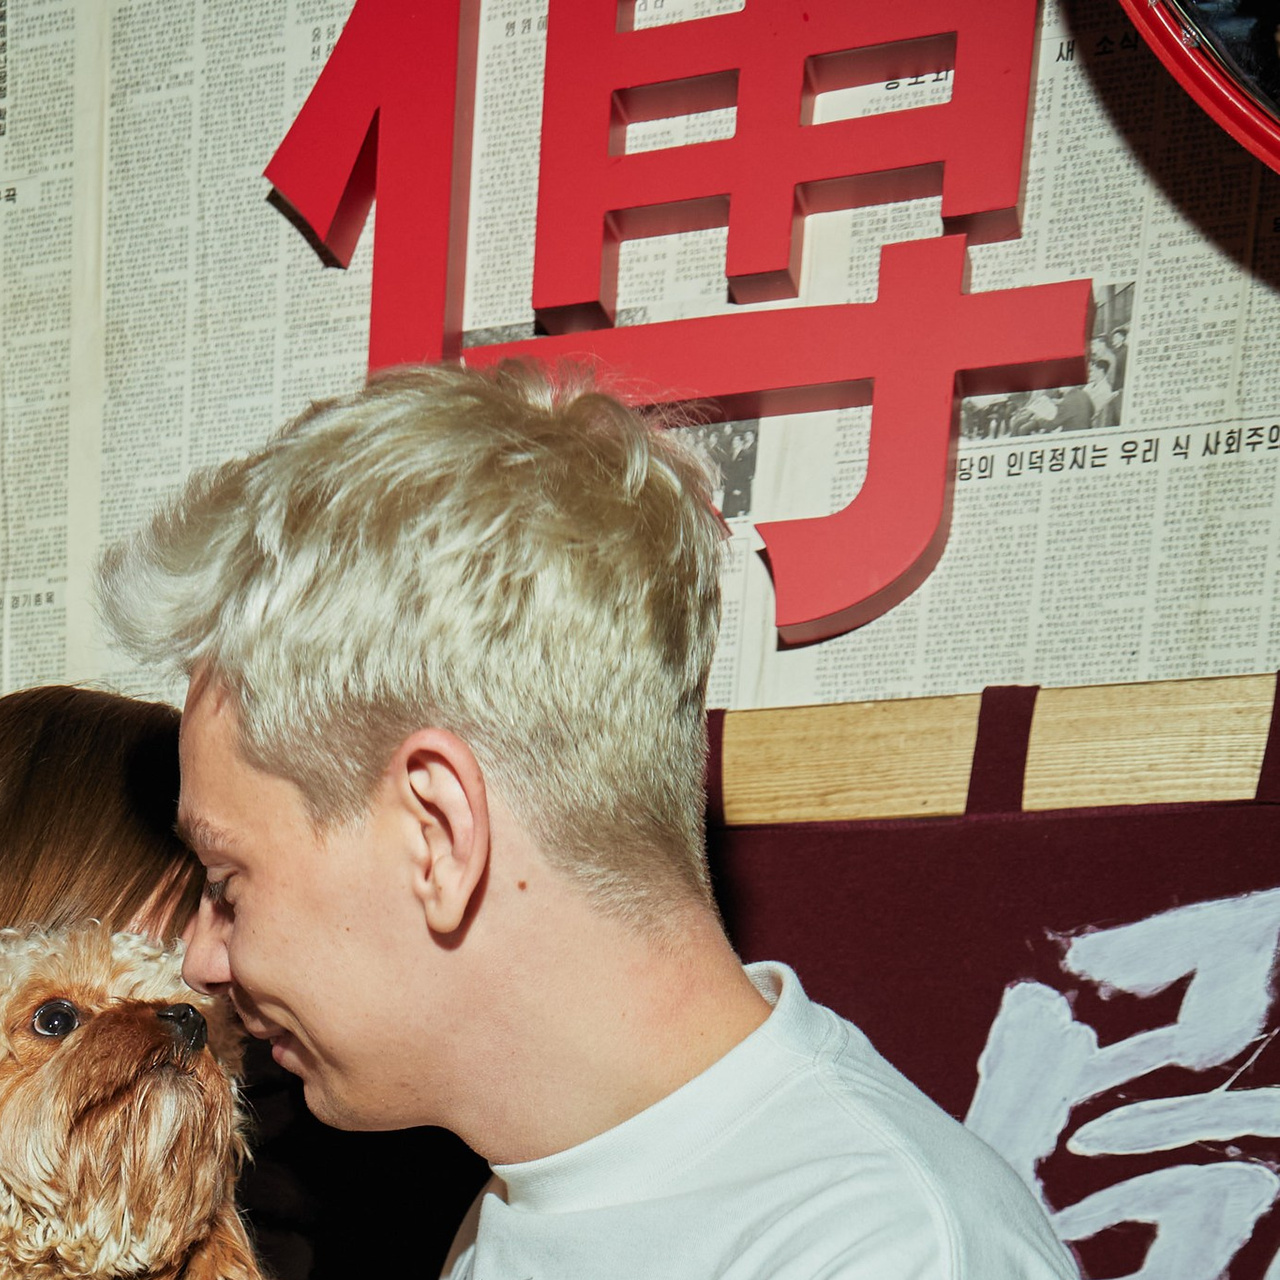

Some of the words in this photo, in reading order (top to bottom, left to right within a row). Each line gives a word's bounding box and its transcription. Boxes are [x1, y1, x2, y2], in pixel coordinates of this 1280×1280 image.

[1056, 38, 1076, 63] 새
[1006, 444, 1109, 477] 인덕정치는
[1120, 437, 1161, 463] 우리
[1172, 433, 1191, 460] 식
